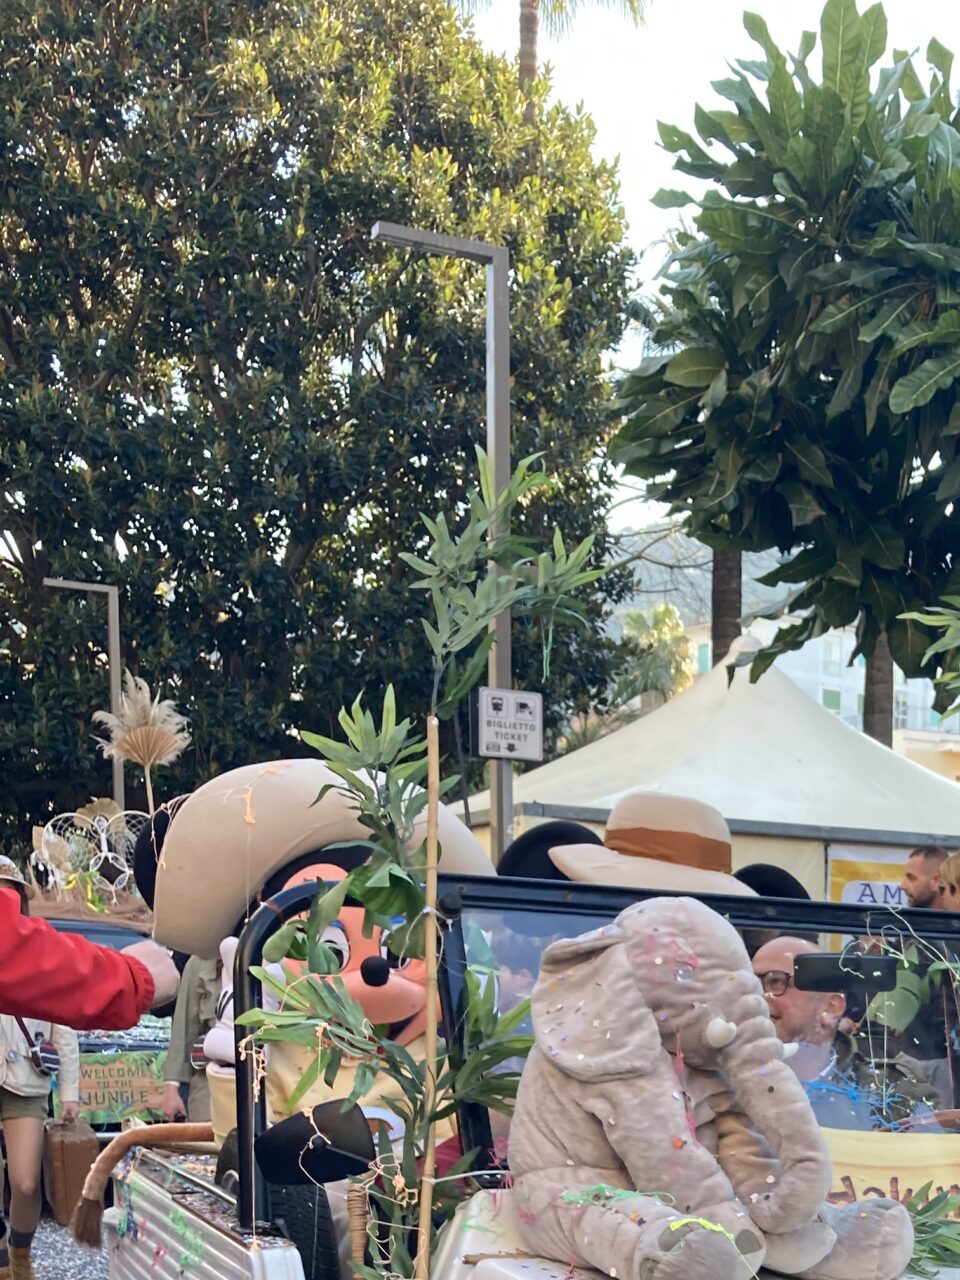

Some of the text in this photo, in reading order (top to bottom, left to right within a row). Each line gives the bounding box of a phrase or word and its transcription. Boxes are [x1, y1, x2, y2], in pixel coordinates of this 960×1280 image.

[486, 720, 536, 732] BIGLIETTO
[494, 731, 528, 742] TICKET
[81, 1066, 147, 1079] WELCOME
[96, 1080, 134, 1089] TO THE
[82, 1089, 149, 1106] JUNGLE
